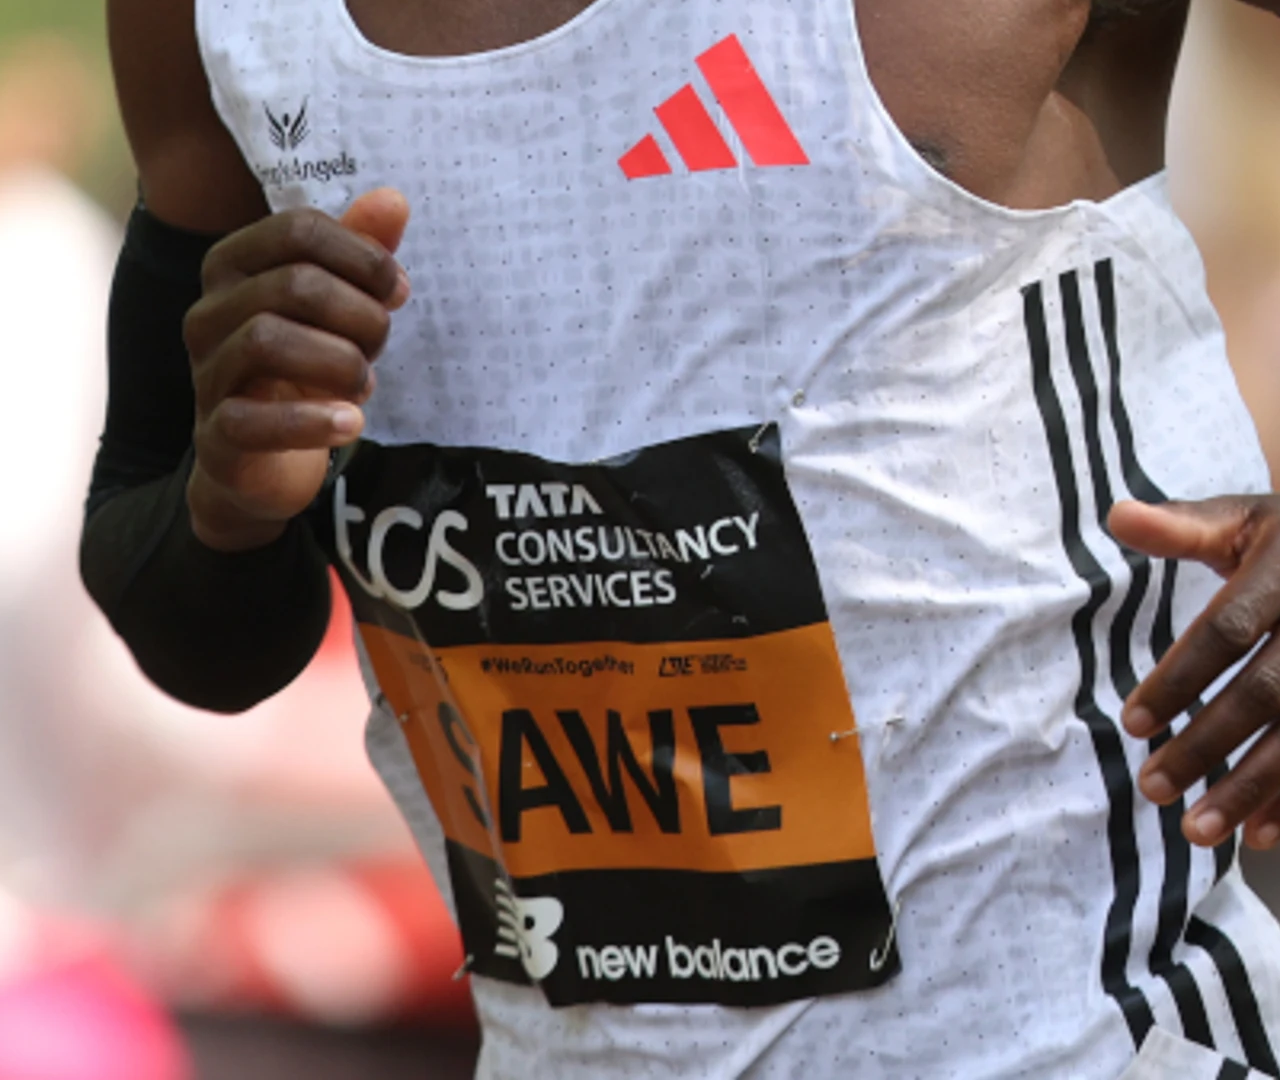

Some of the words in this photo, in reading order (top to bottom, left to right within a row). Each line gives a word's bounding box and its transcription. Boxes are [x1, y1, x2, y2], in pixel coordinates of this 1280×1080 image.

[486, 482, 603, 519] TATA
[495, 512, 760, 565] CONSULTANCY
[505, 570, 677, 610] SERVICES
[577, 944, 659, 980] new
[665, 935, 841, 982] balance
